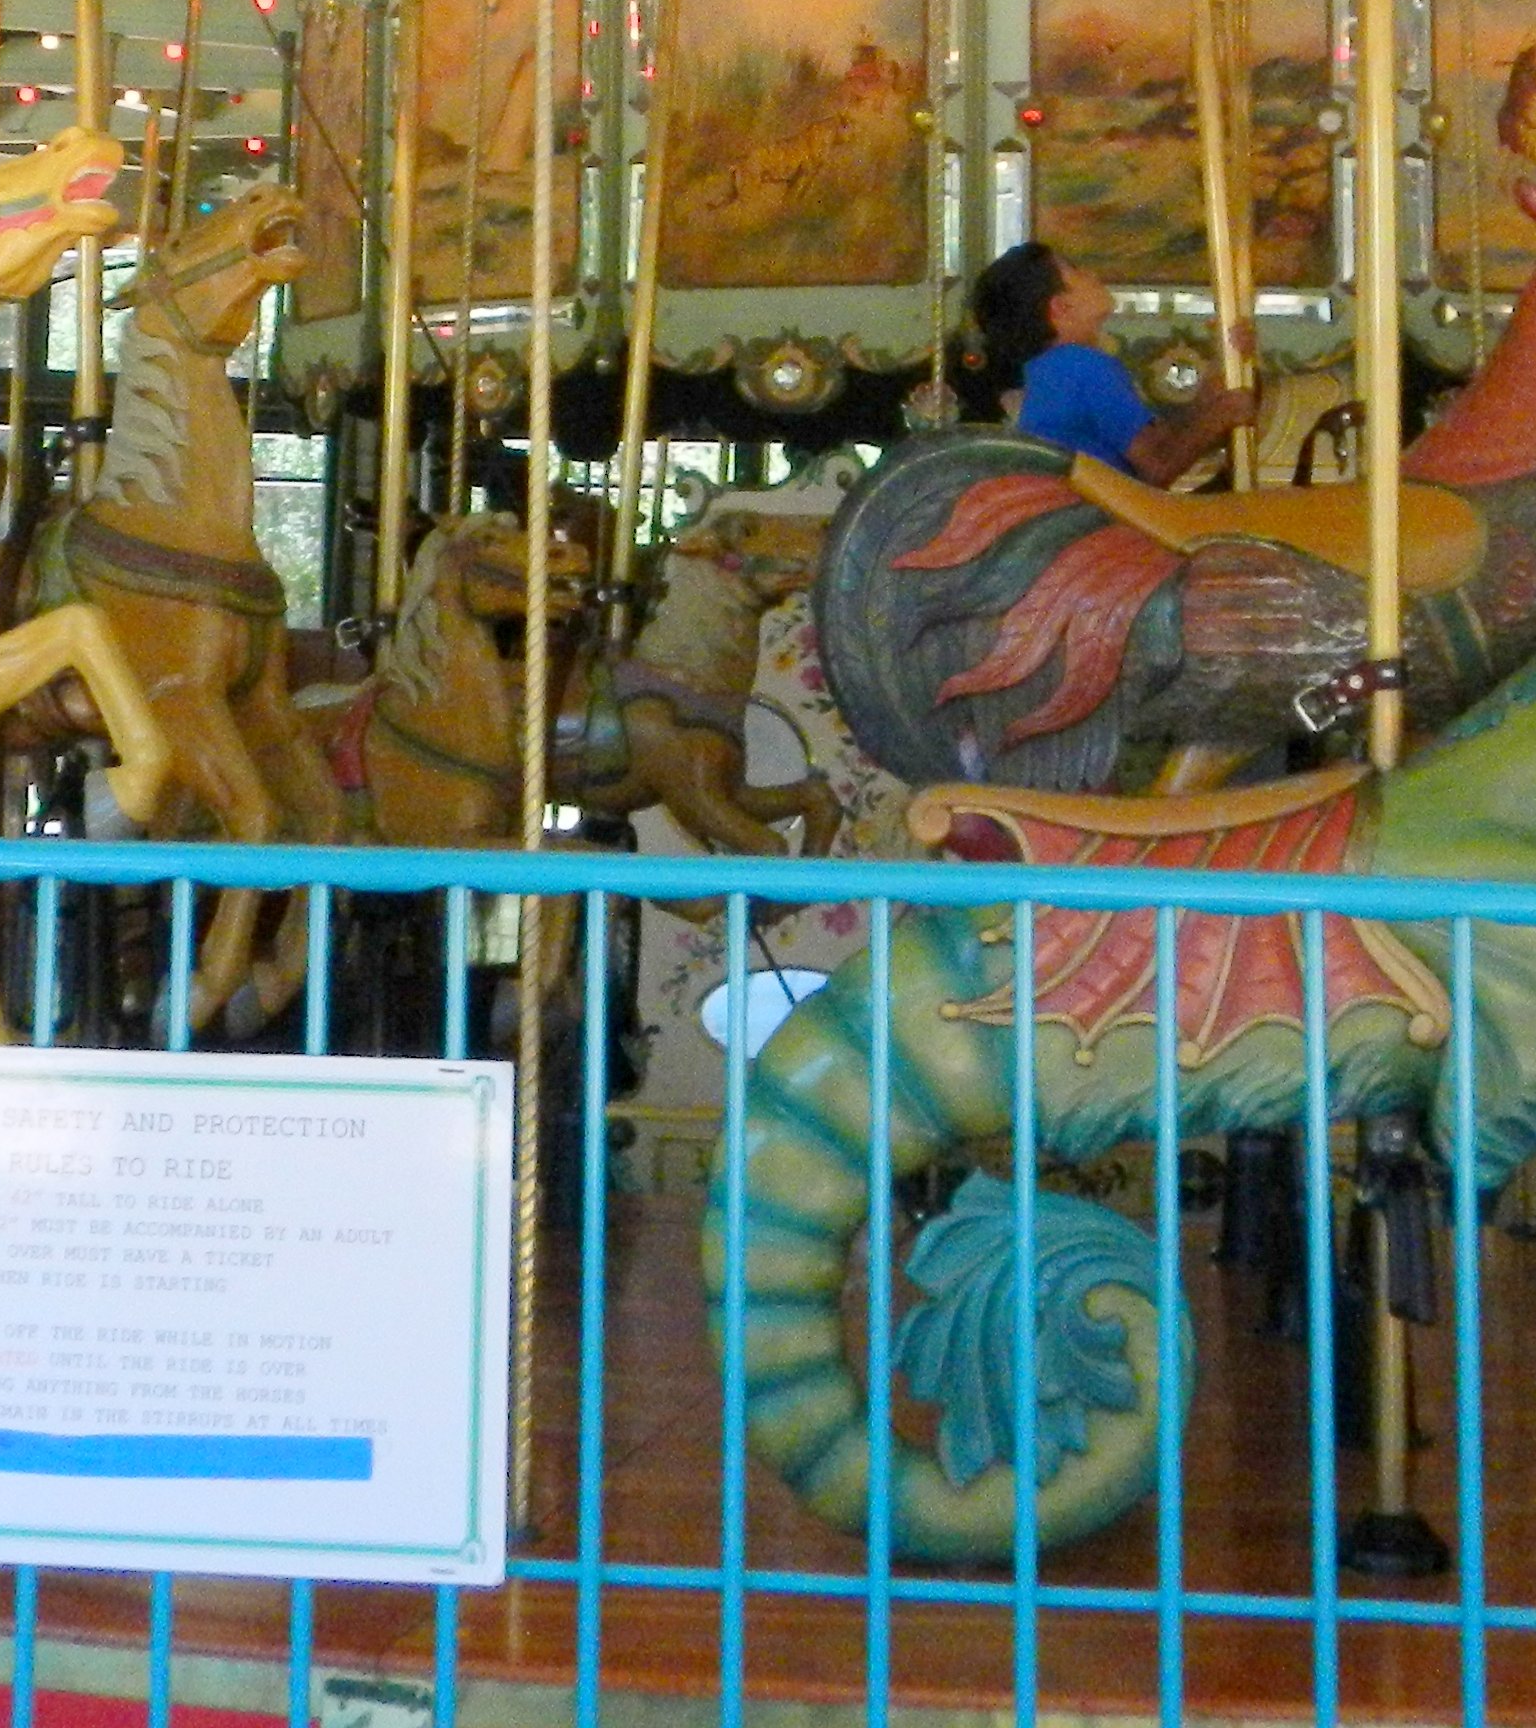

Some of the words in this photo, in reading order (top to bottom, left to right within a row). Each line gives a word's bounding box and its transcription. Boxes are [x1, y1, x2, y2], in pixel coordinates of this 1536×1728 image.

[3, 1107, 103, 1131] SAFETY
[122, 1112, 174, 1133] AND
[193, 1114, 367, 1140] PROTECTION
[8, 1153, 92, 1176] RULES
[112, 1156, 146, 1177] TO
[164, 1158, 233, 1180] RIDE
[56, 1192, 100, 1209] TALL
[114, 1194, 136, 1210] TO
[147, 1195, 194, 1212] RIDE
[206, 1197, 264, 1214] ALONE
[31, 1218, 78, 1234] MUST
[90, 1220, 112, 1236] BE
[123, 1221, 252, 1241] ACCOMPANIED
[264, 1226, 287, 1242] BY
[299, 1228, 323, 1243] AN
[334, 1228, 394, 1246] ADULT
[7, 1243, 54, 1260] OVER
[65, 1245, 112, 1262] MUST
[123, 1248, 169, 1264] HAVE
[181, 1250, 192, 1265] A
[205, 1250, 274, 1268] TICKET
[41, 1271, 87, 1288] RIDE
[100, 1273, 121, 1290] IS
[134, 1274, 228, 1293] STARTING
[4, 1323, 39, 1339] OFF
[52, 1325, 84, 1342] THE
[96, 1326, 144, 1344] RIDE
[155, 1328, 214, 1347] WHILE
[228, 1331, 250, 1348] IN
[260, 1332, 333, 1351] MOTION
[50, 1351, 107, 1370] UNTIL
[119, 1354, 154, 1371] THE
[165, 1356, 213, 1374] RIDE
[227, 1358, 248, 1375] IS
[259, 1359, 306, 1378] OVER
[26, 1377, 119, 1397] ANYTHING
[130, 1381, 178, 1399] FROM
[190, 1384, 223, 1401] THE
[95, 1407, 129, 1425] THE
[245, 1414, 271, 1430] AT
[282, 1415, 318, 1434] ALL
[330, 1417, 389, 1436] TIMES
